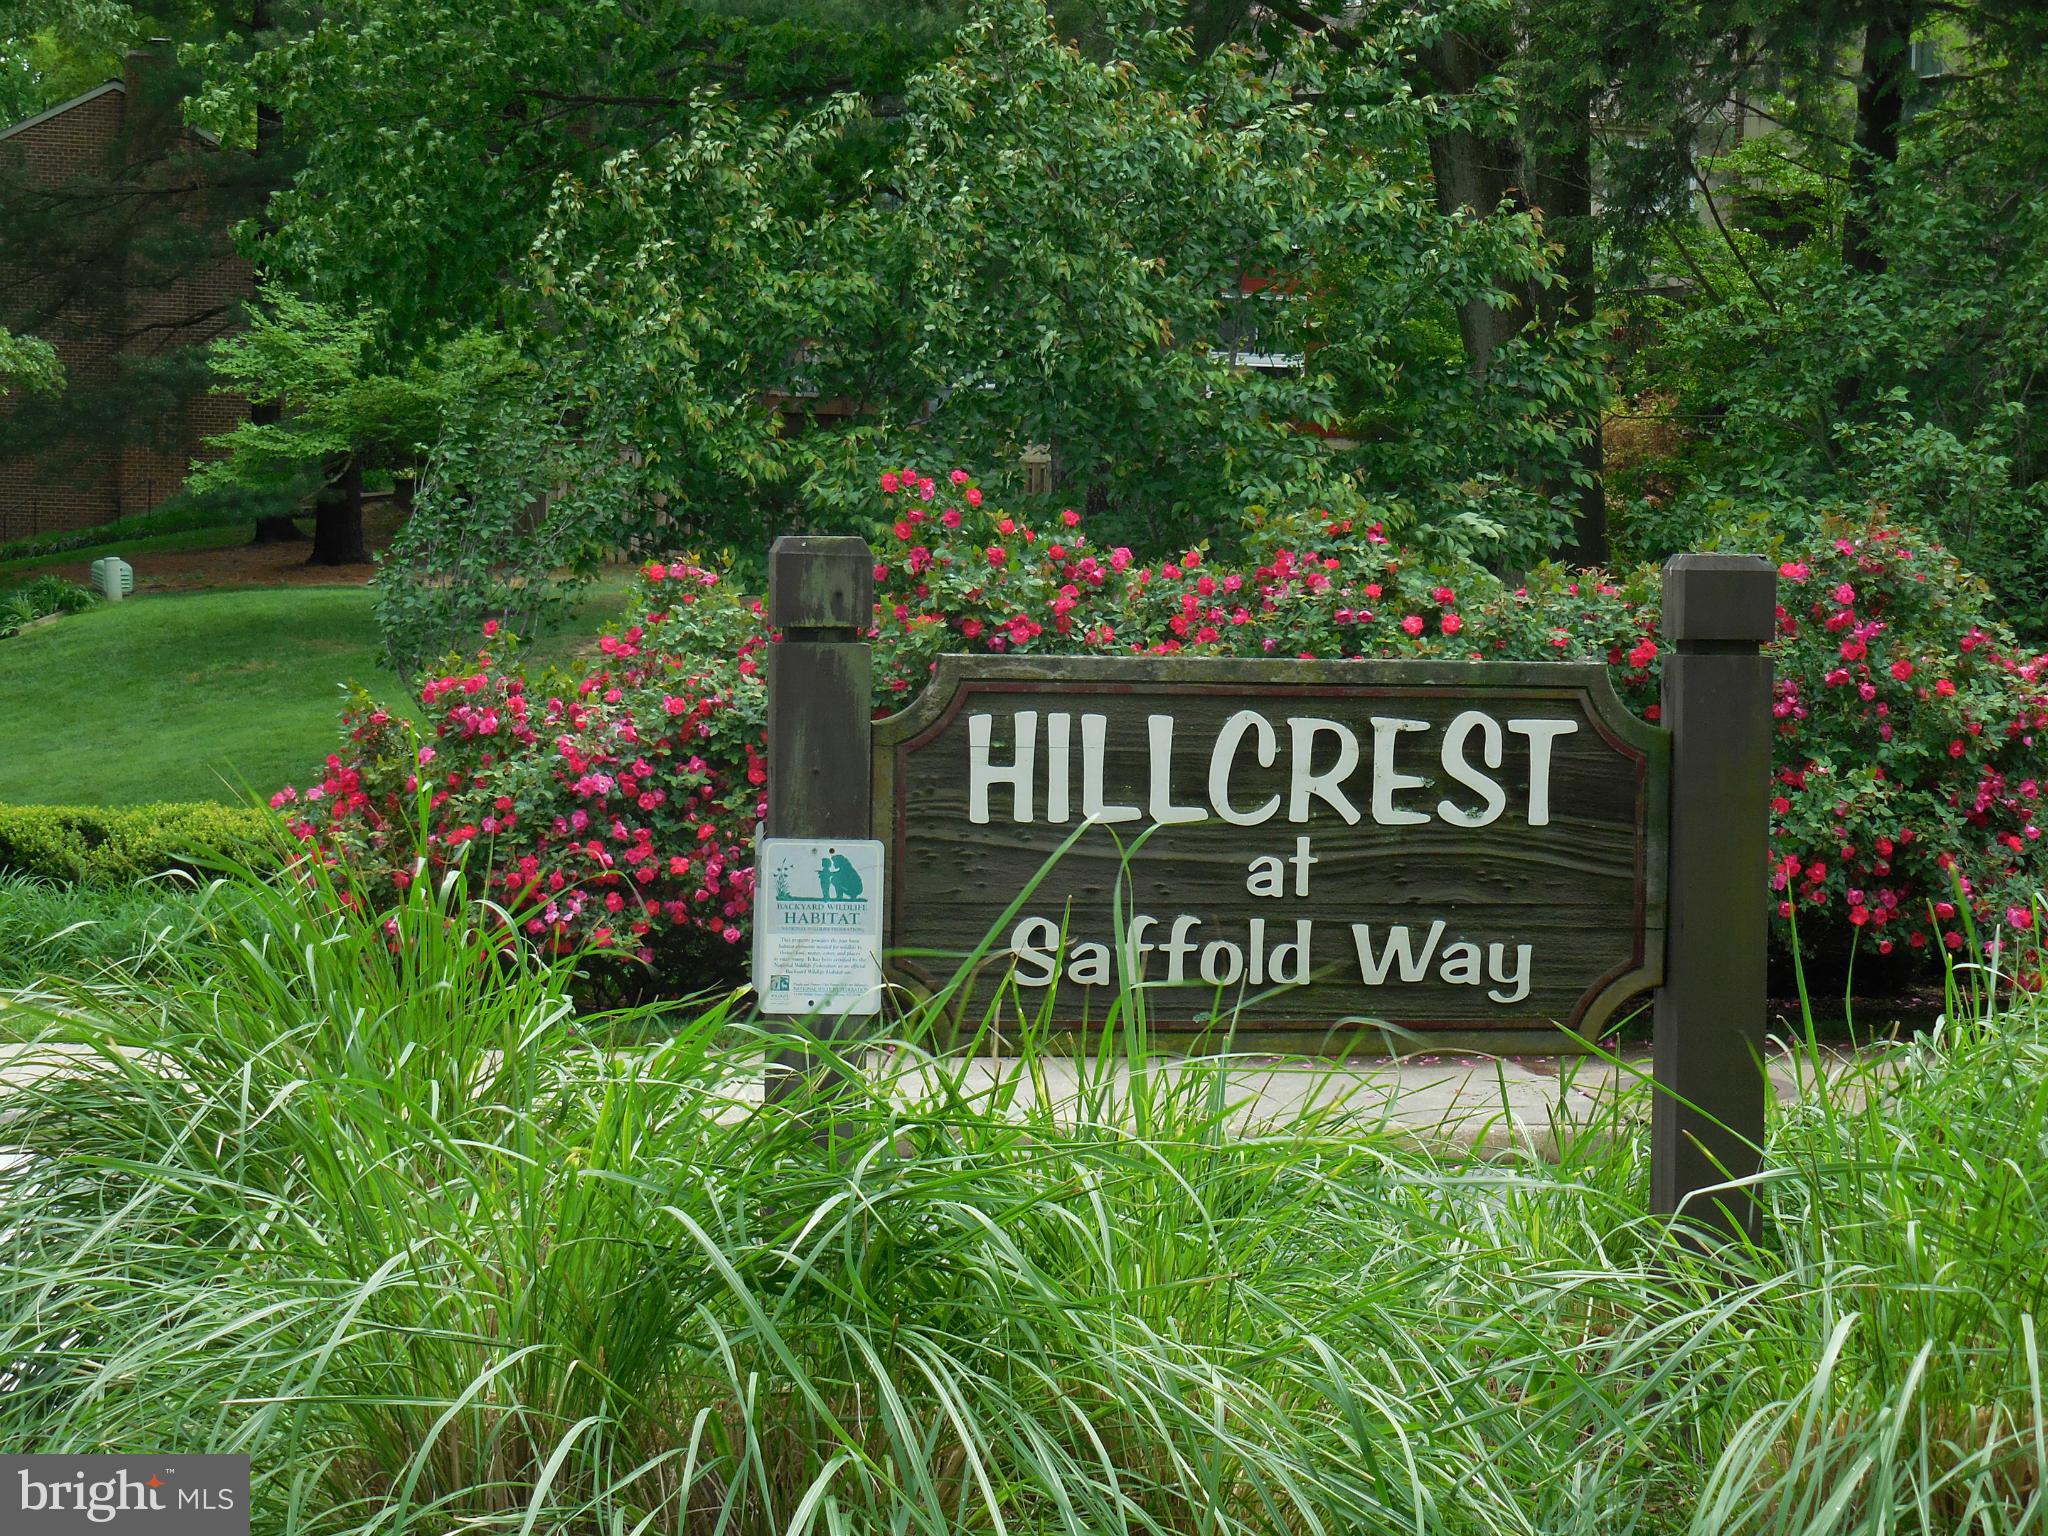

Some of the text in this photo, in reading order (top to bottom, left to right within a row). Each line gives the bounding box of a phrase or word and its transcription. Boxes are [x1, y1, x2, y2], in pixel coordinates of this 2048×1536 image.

[968, 709, 1579, 828] HILLCREST
[1246, 836, 1319, 898] at
[776, 903, 867, 912] BACKYARD WILDLIFE
[784, 912, 861, 925] HABITAT
[1011, 914, 1533, 1003] Saffold Way
